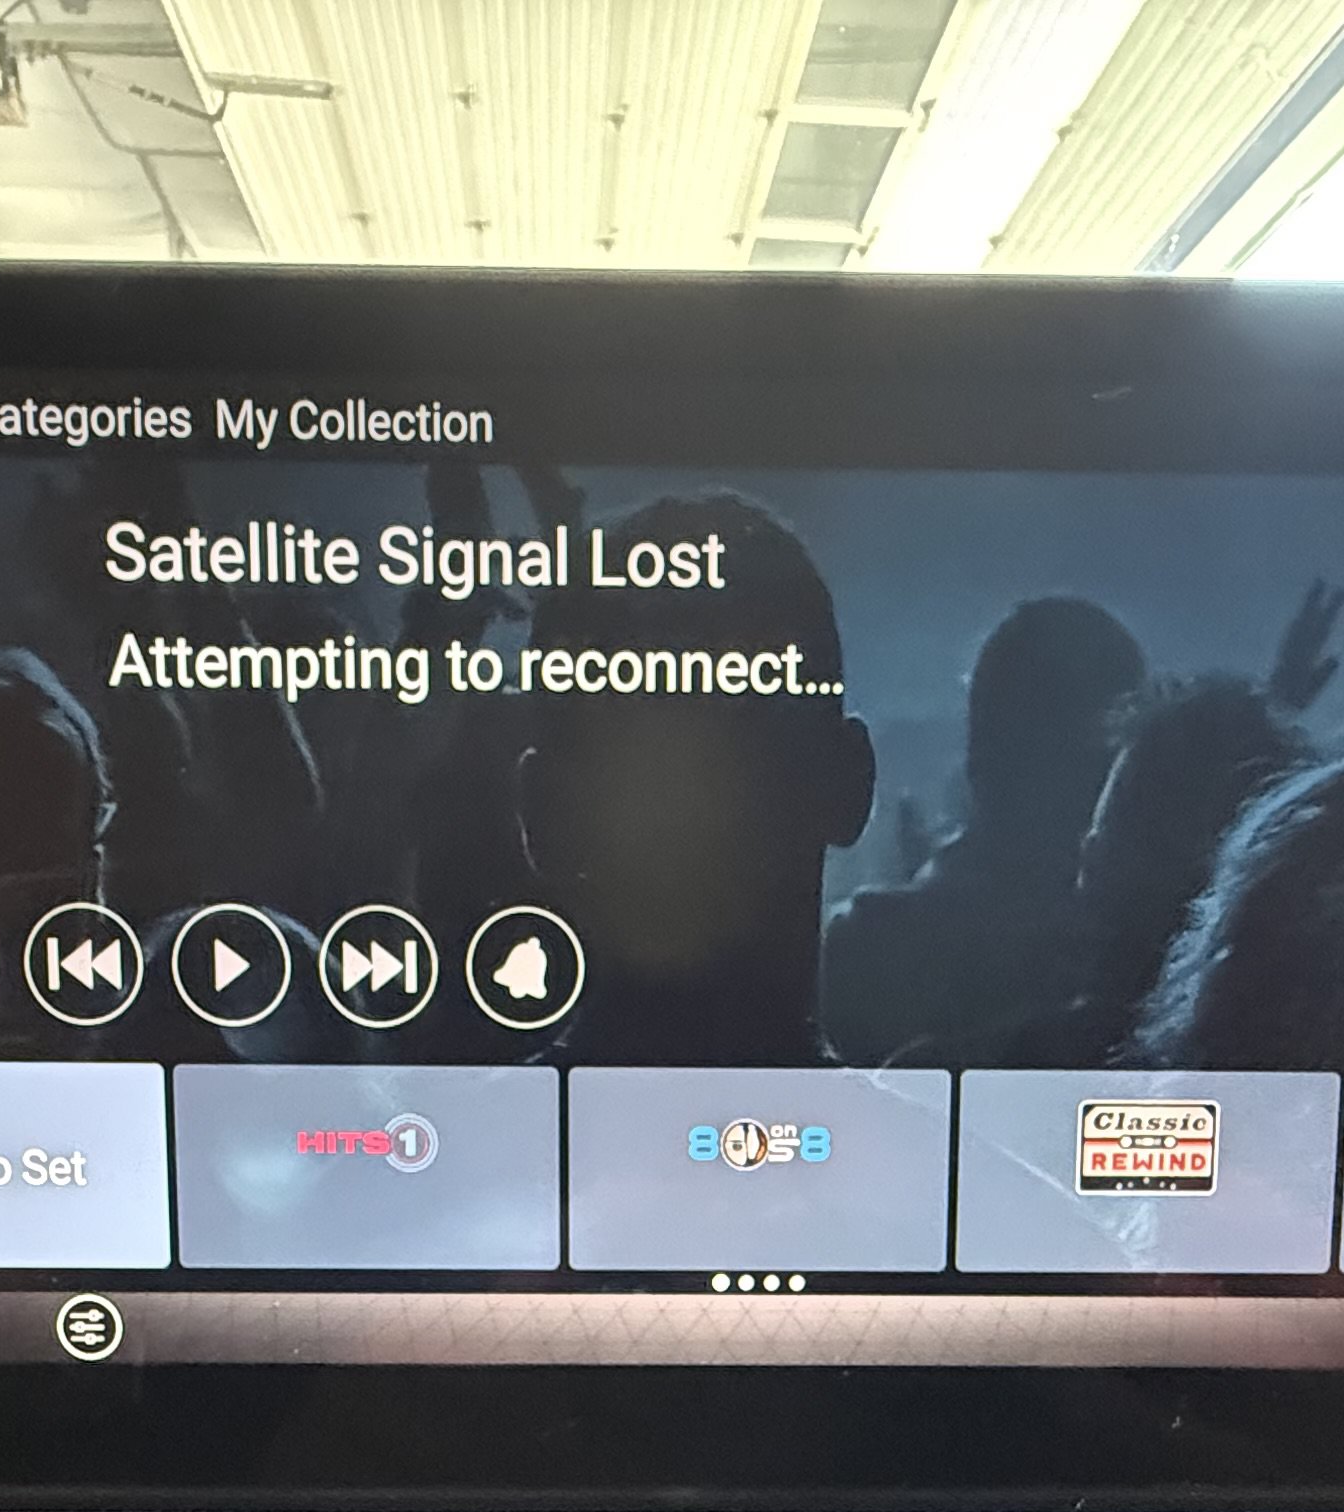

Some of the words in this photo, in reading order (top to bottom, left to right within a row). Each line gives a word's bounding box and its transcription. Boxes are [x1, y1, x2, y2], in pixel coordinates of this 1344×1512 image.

[216, 400, 279, 450] My
[289, 400, 493, 444] Collection
[104, 521, 360, 584] Satellite
[378, 525, 568, 600] Signal
[592, 530, 726, 590] Lost
[108, 634, 431, 703] Attempting
[446, 640, 504, 692] to
[520, 643, 846, 696] reconnect...
[1092, 1111, 1208, 1133] Classic
[296, 1131, 392, 1155] HITS
[21, 1150, 87, 1187] Set
[1091, 1151, 1206, 1173] REWIND
